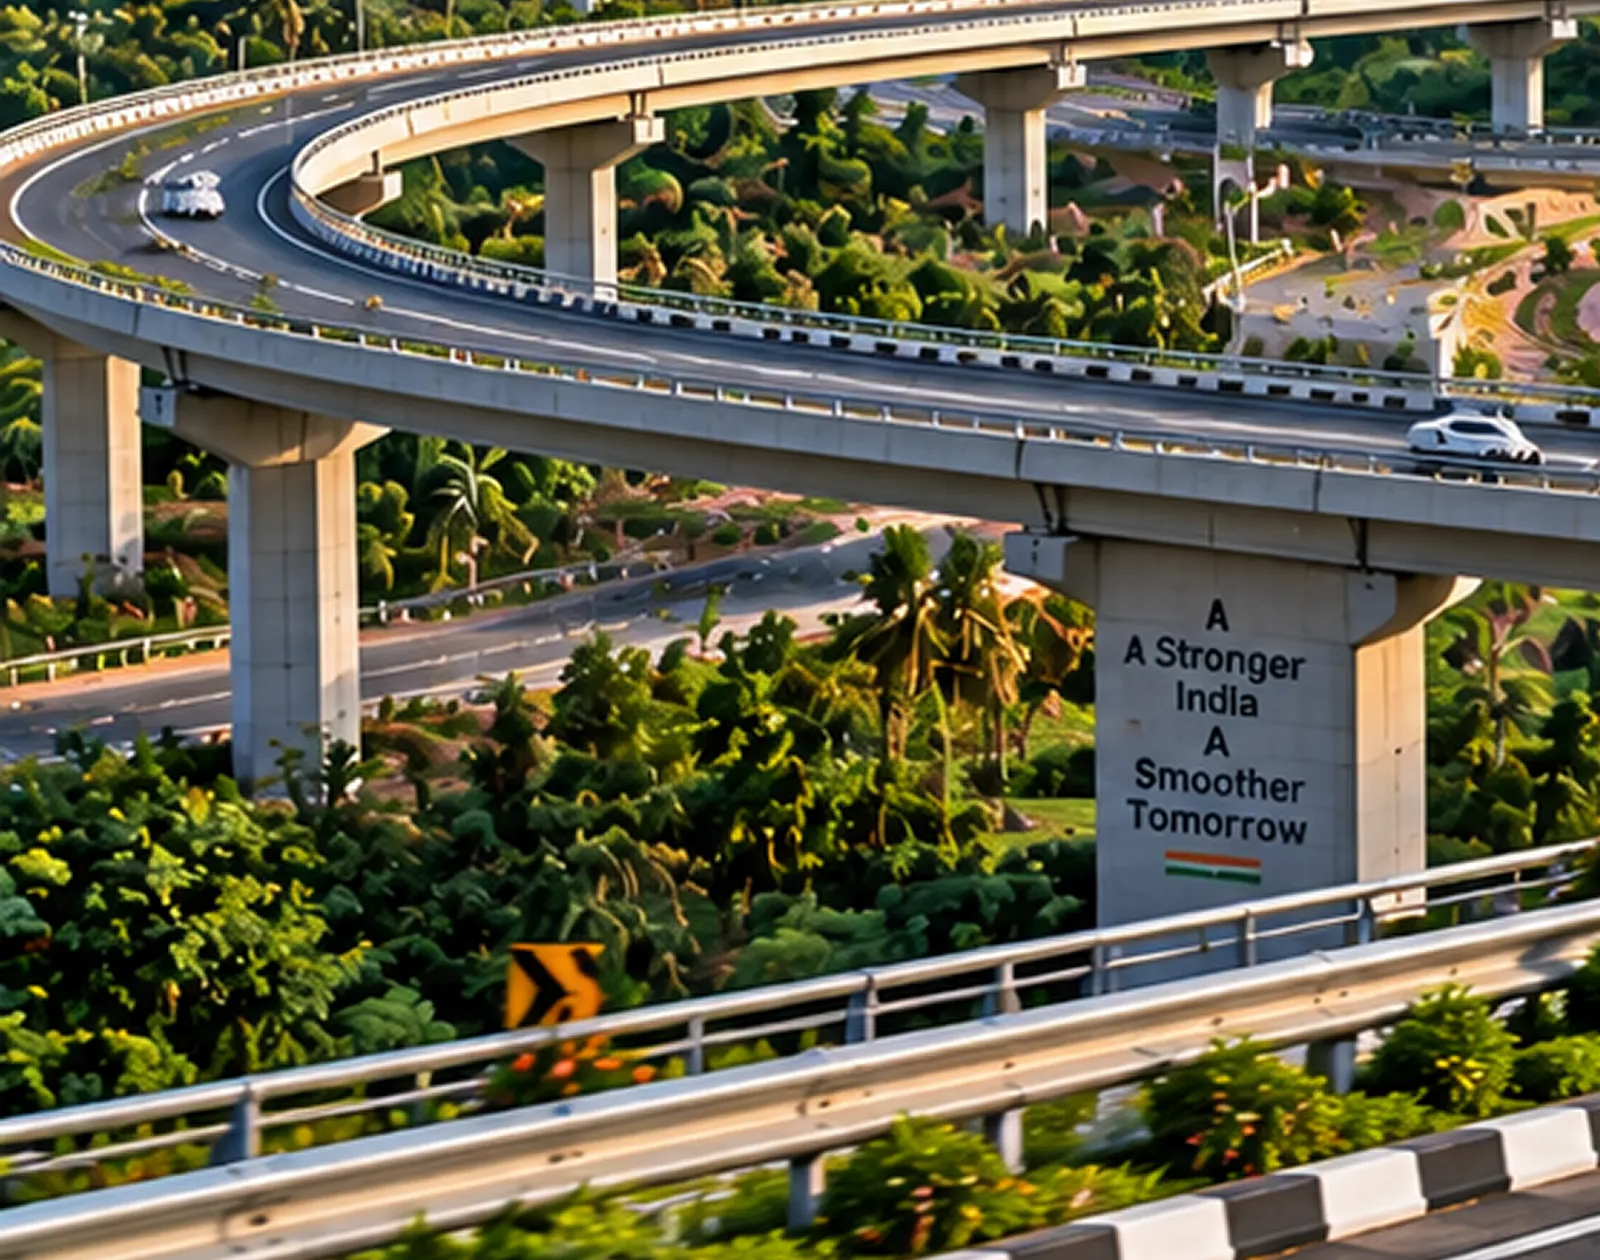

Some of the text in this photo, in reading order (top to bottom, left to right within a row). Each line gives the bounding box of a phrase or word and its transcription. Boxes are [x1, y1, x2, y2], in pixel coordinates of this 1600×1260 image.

[1206, 598, 1229, 632] A
[1124, 636, 1306, 684] A Stronger
[1204, 726, 1230, 757] A
[1135, 757, 1305, 802] Smoother
[1126, 798, 1307, 844] Tomorrow
